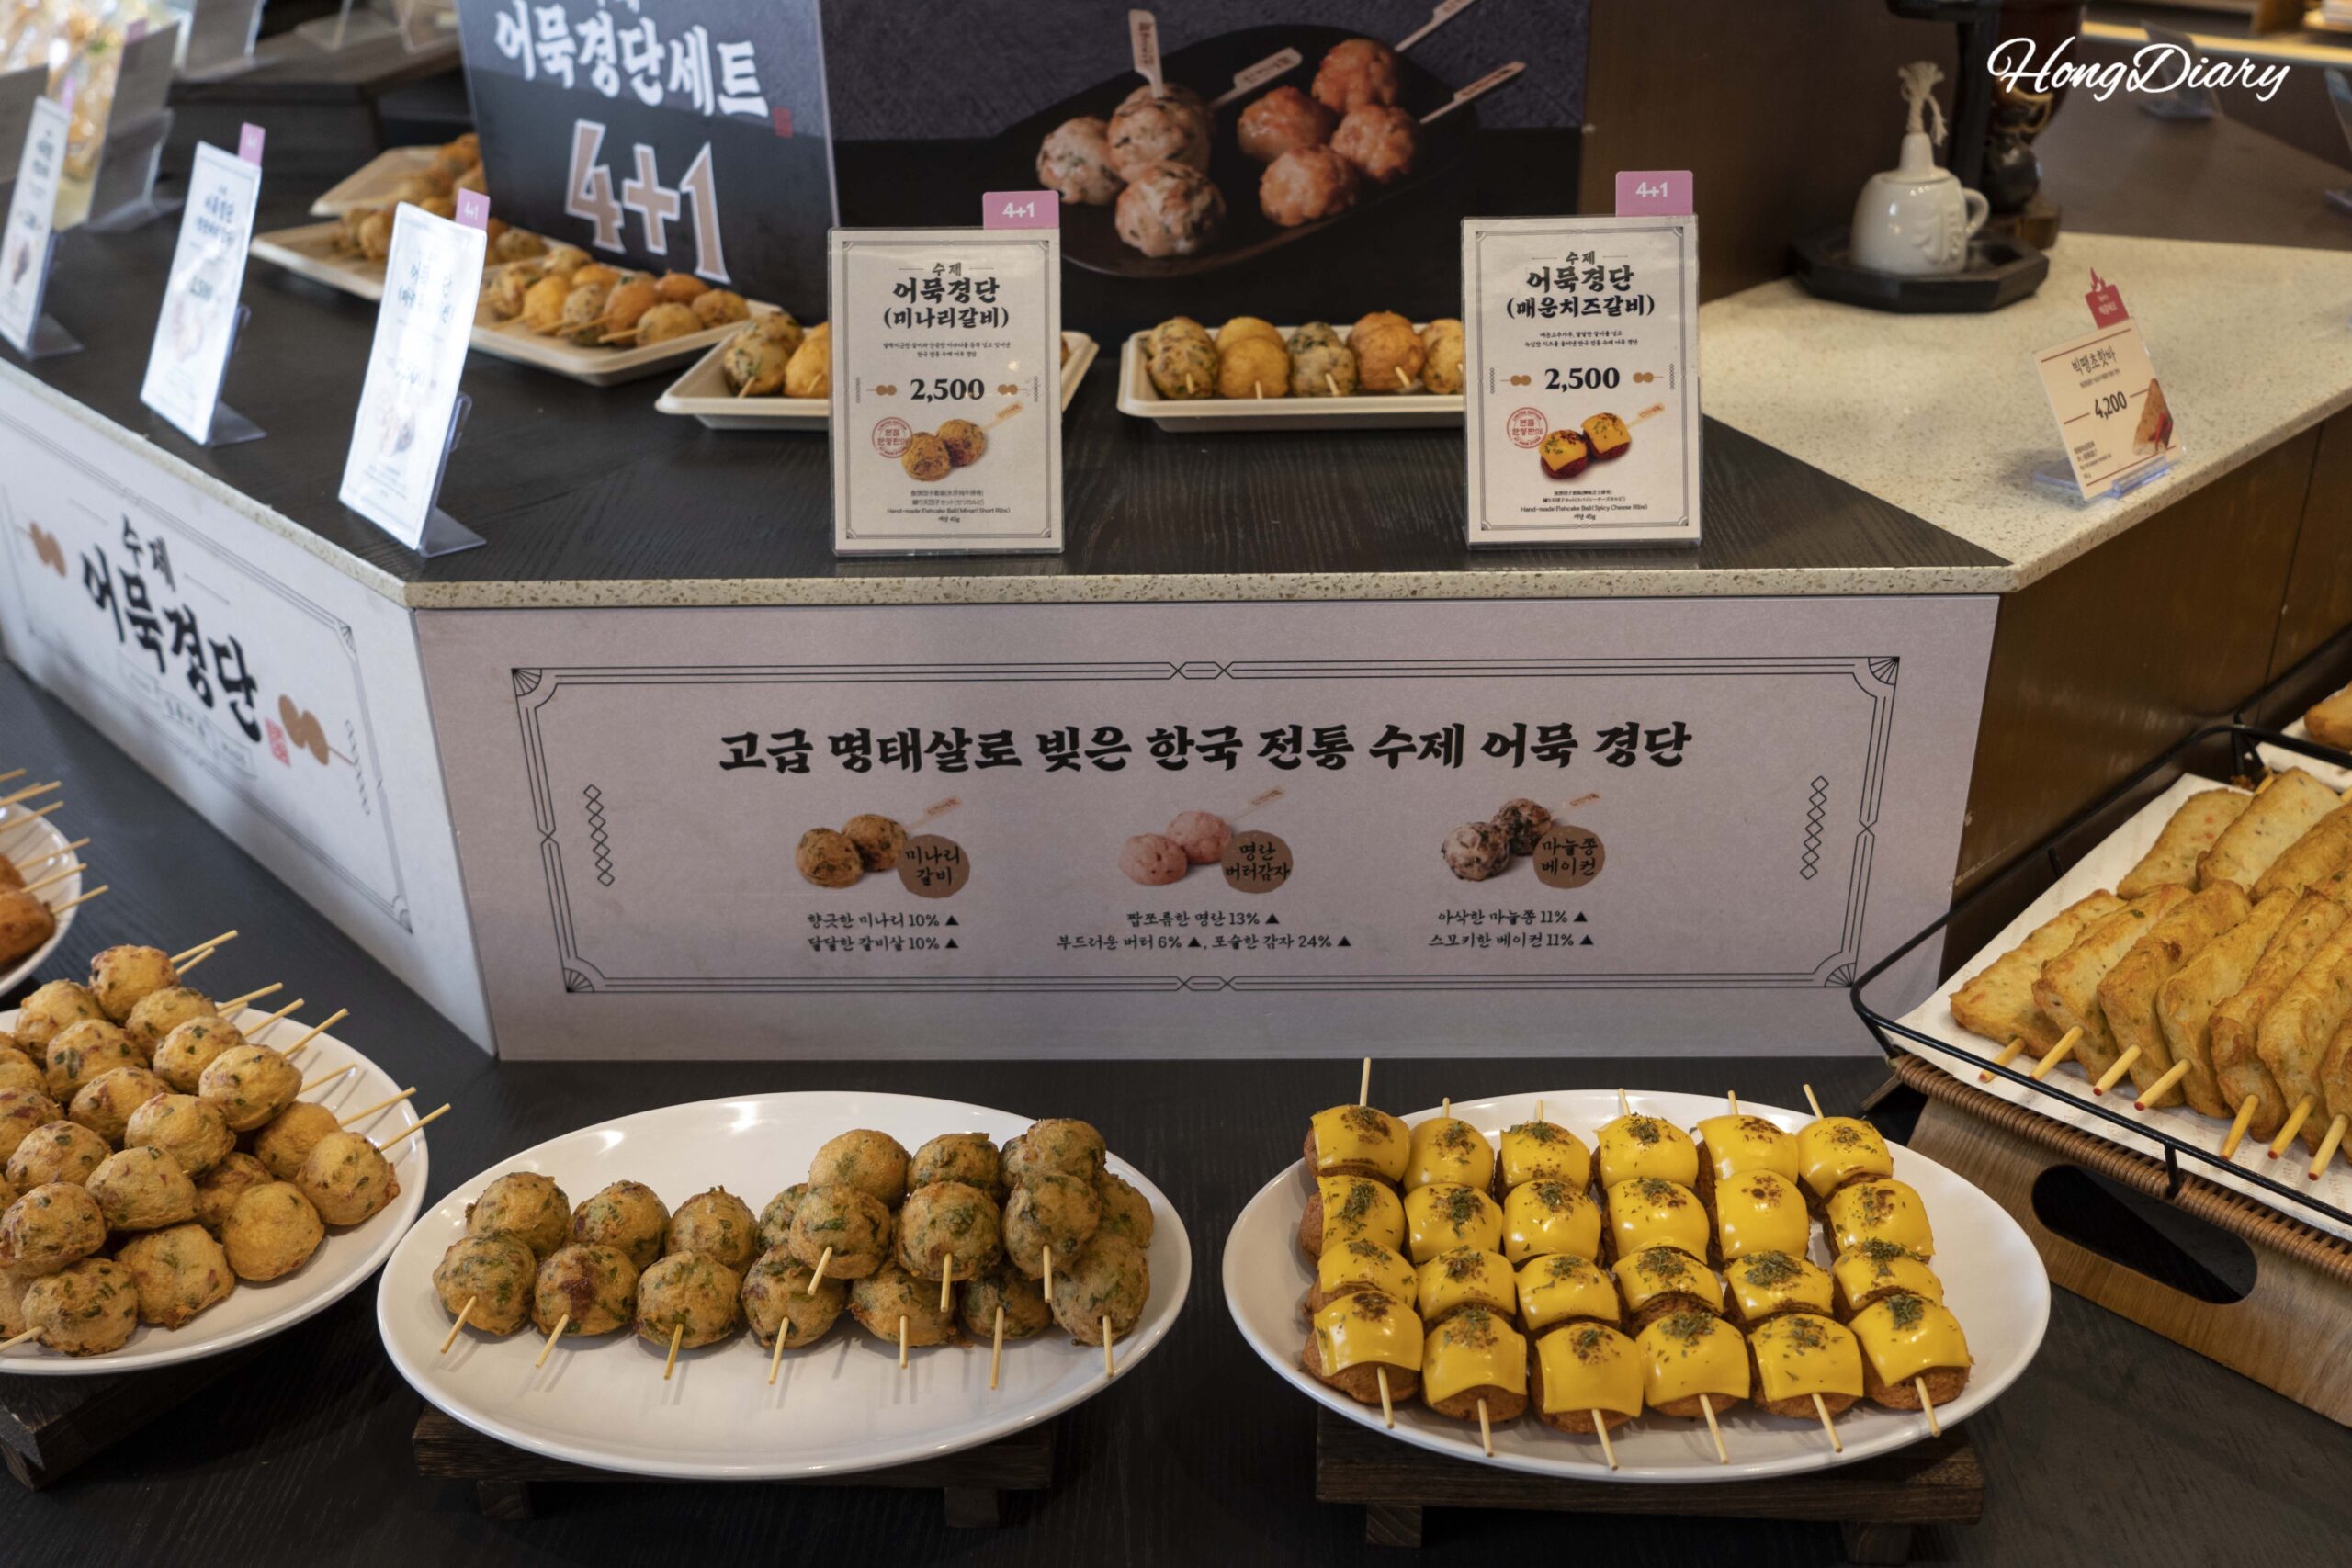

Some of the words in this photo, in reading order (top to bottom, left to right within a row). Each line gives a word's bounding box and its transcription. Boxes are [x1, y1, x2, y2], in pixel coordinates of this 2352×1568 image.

[494, 0, 768, 118] 어묵경단세트
[1635, 181, 1669, 198] 4+1
[564, 119, 731, 285] 4+1
[1002, 202, 1035, 219] 4+1
[1566, 251, 1595, 265] 수제
[932, 262, 962, 276] 수제
[1526, 265, 1634, 293] 어묵경단
[892, 277, 1000, 304] 어묵경단
[1507, 294, 1656, 319] (매운치즈갈비)
[884, 307, 1009, 328] (미나리갈비)
[1545, 367, 1620, 392] 2,500
[911, 379, 984, 402] 2,500
[2095, 391, 2127, 420] 4,200
[123, 514, 175, 592] 수제
[82, 544, 261, 743] 어묵경단
[719, 728, 813, 773] 고급
[828, 727, 1022, 773] 명태살로
[1036, 727, 1132, 772] 빚은
[1146, 725, 1243, 771] 한국
[1258, 725, 1354, 770] 전통
[1369, 723, 1464, 769] 수제
[1480, 722, 1578, 768] 어묵
[1593, 721, 1692, 767] 경단
[905, 846, 959, 864] 미나리
[1239, 841, 1275, 861] 명란
[1541, 836, 1598, 856] 마늘쫑
[1226, 863, 1290, 881] 버터감자
[1542, 857, 1595, 876] 베이컨
[917, 867, 951, 886] 갈비
[808, 913, 854, 929] 향긋한
[859, 913, 904, 928] 미나리
[909, 914, 939, 927] 10%
[1127, 911, 1190, 927] 짭쪼름한
[1195, 911, 1225, 927] 명란
[1230, 913, 1260, 925] 13%
[1439, 909, 1485, 925] 아삭한
[1489, 909, 1536, 925] 마늘쫑
[1541, 911, 1567, 923] 11%
[808, 936, 854, 952] 달달한
[860, 936, 904, 952] 갈비살
[910, 937, 939, 950] 10%
[1057, 935, 1118, 950] 부드러운
[1124, 934, 1153, 949] 버터
[1158, 936, 1182, 948] 6%
[1213, 934, 1259, 950] 포슬한
[1264, 934, 1294, 949] 감자
[1299, 936, 1331, 947] 24%
[1429, 933, 1492, 948] 스모키한
[1497, 932, 1542, 948] 베이컨
[1547, 934, 1574, 946] 11%
